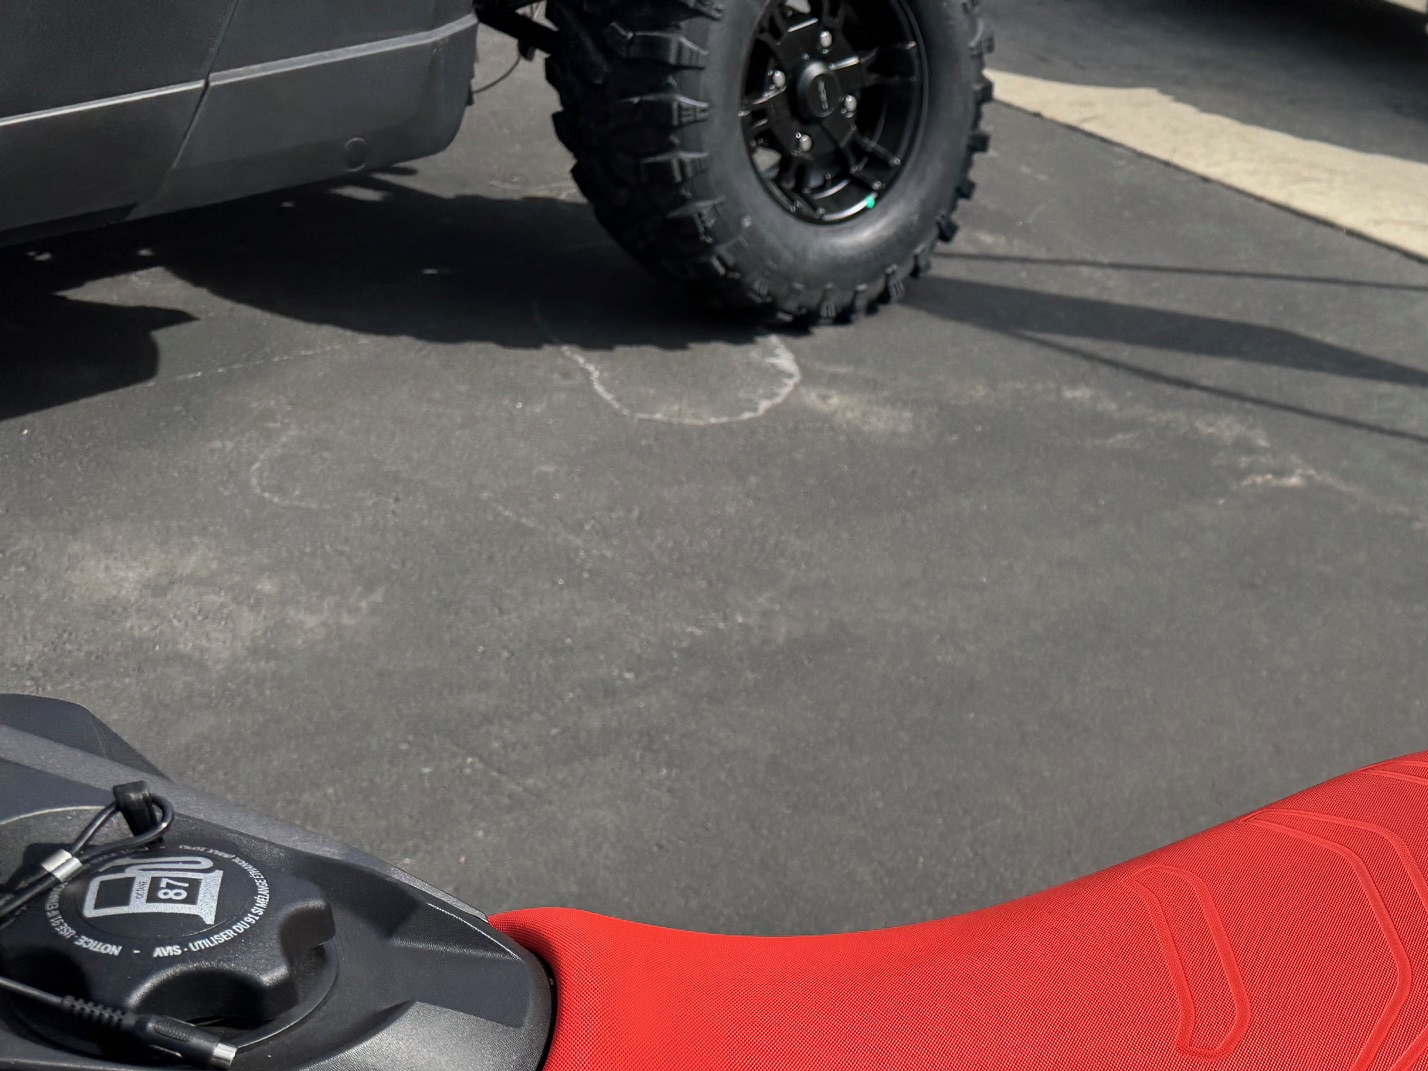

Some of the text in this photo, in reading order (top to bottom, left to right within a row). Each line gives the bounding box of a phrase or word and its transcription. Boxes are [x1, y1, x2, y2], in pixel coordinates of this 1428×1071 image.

[157, 877, 190, 901] 87
[250, 905, 265, 915] SI
[244, 913, 259, 924] 91
[55, 922, 76, 939] USE
[232, 920, 250, 934] DU
[73, 935, 123, 956] NOTICE
[188, 928, 237, 952] UTILISER
[153, 945, 182, 958] AVIS
